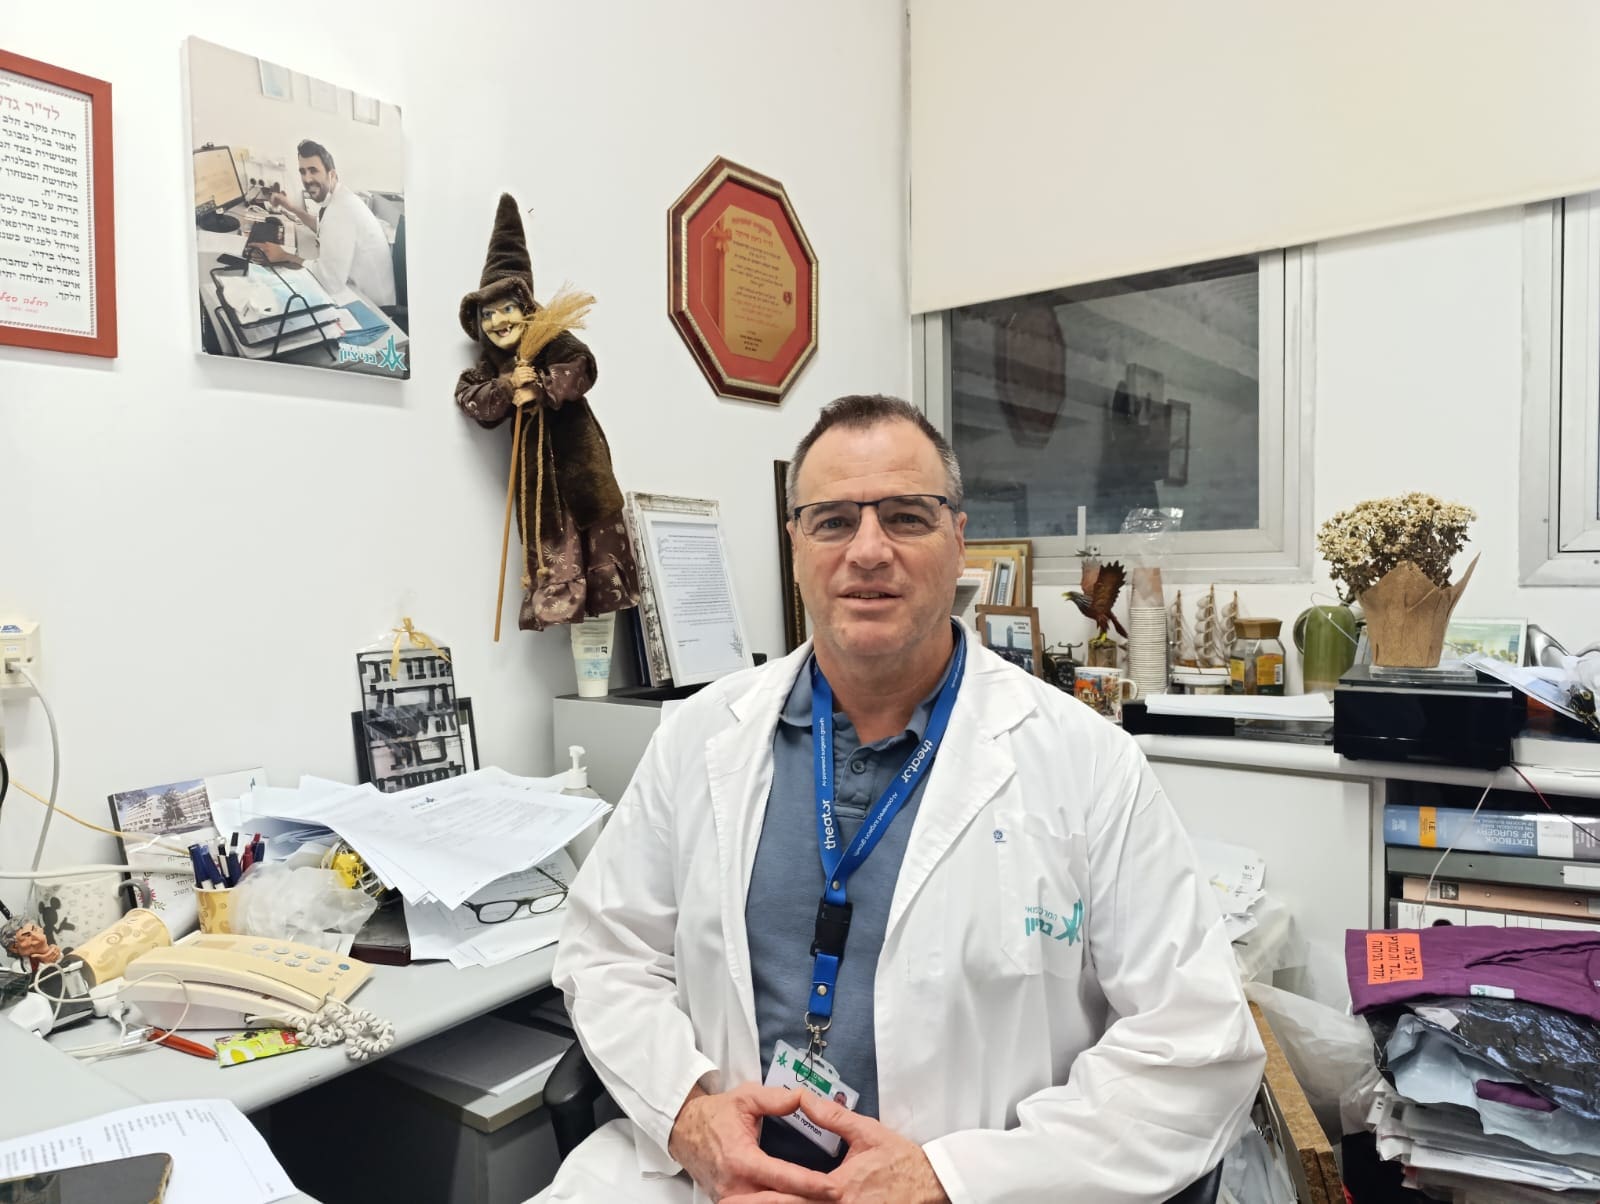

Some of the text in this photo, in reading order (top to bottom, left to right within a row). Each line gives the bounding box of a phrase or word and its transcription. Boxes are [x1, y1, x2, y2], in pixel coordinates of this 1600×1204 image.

[28, 198, 39, 208] כך
[42, 200, 54, 210] על
[57, 205, 78, 215] תודה
[21, 210, 47, 221] טובות
[60, 230, 79, 240] אתה
[32, 262, 43, 272] לך
[56, 279, 80, 289] אושר
[901, 739, 934, 783] theator
[822, 799, 836, 850] theator
[1476, 829, 1519, 838] SURGERY
[1522, 831, 1535, 839] OF
[1485, 837, 1535, 847] TEXTBOOK
